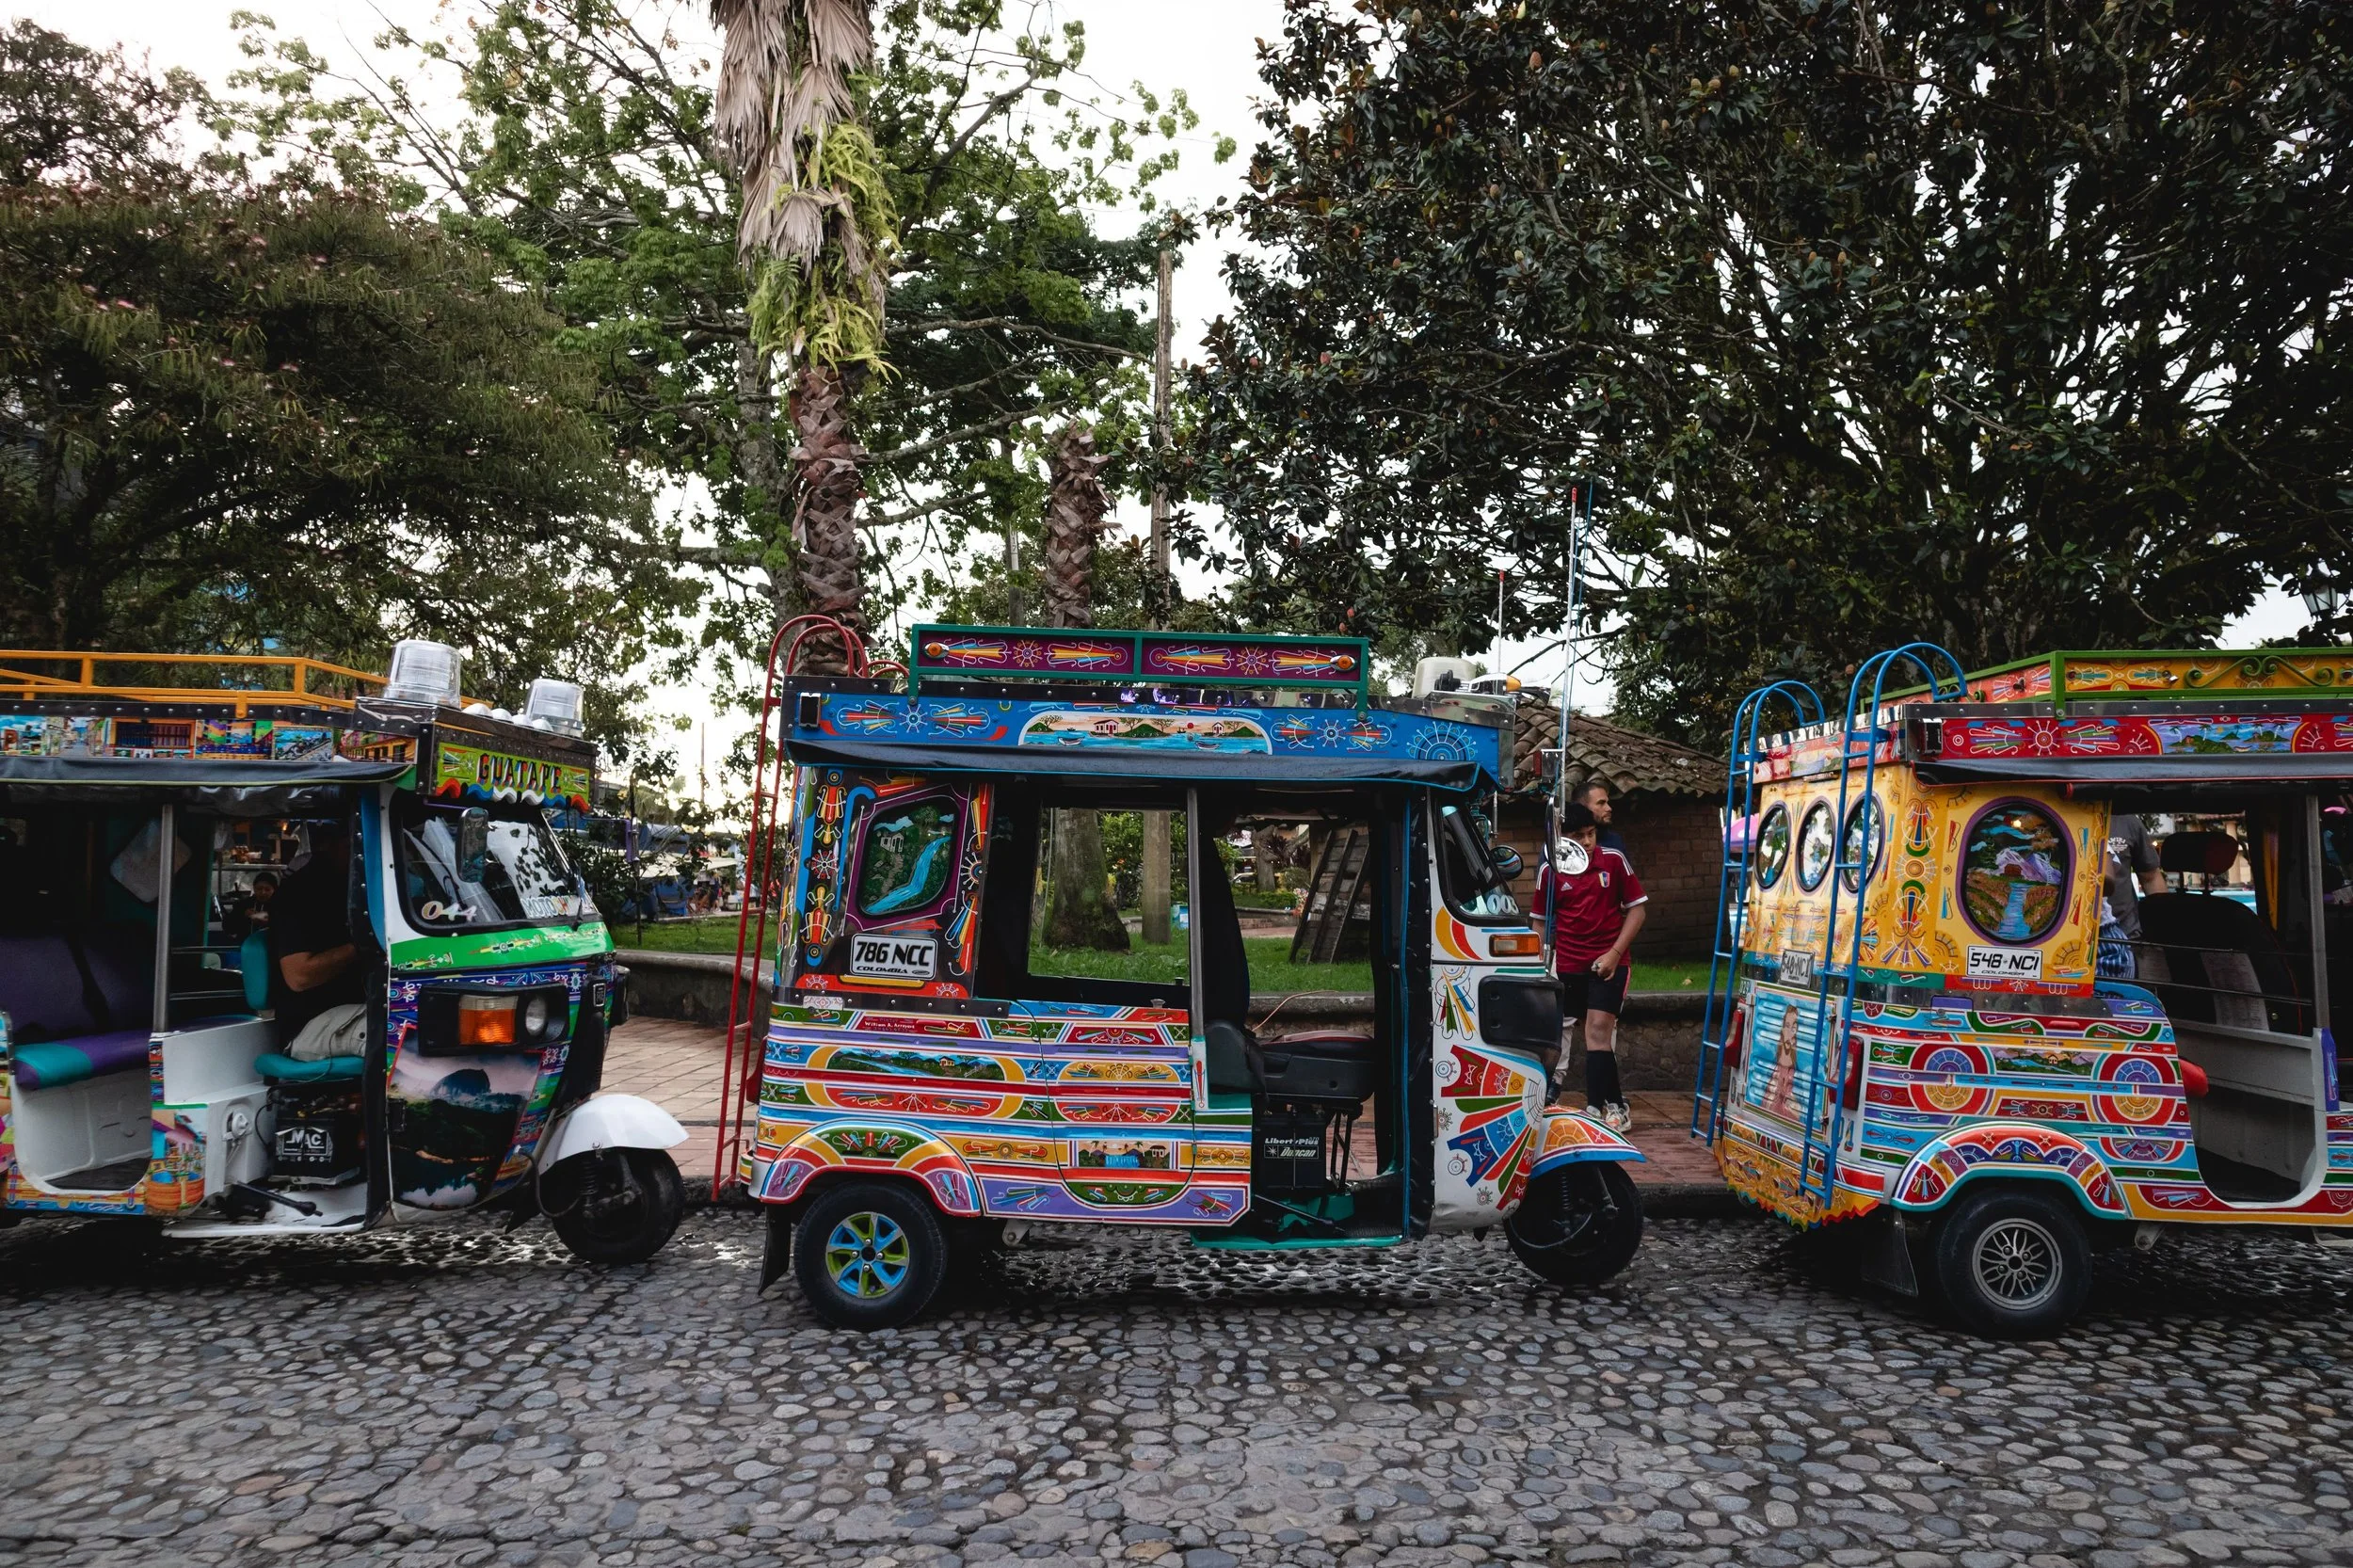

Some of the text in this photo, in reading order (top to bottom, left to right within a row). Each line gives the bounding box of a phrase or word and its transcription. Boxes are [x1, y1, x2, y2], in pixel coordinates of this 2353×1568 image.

[475, 753, 562, 793] GUATAPE
[422, 900, 476, 921] 044
[855, 941, 933, 967] 786 NCC
[1970, 952, 2040, 970] 548 NCI
[856, 966, 908, 974] COLOMBIA
[286, 1129, 324, 1148] MAC
[1280, 1146, 1316, 1158] Duncan
